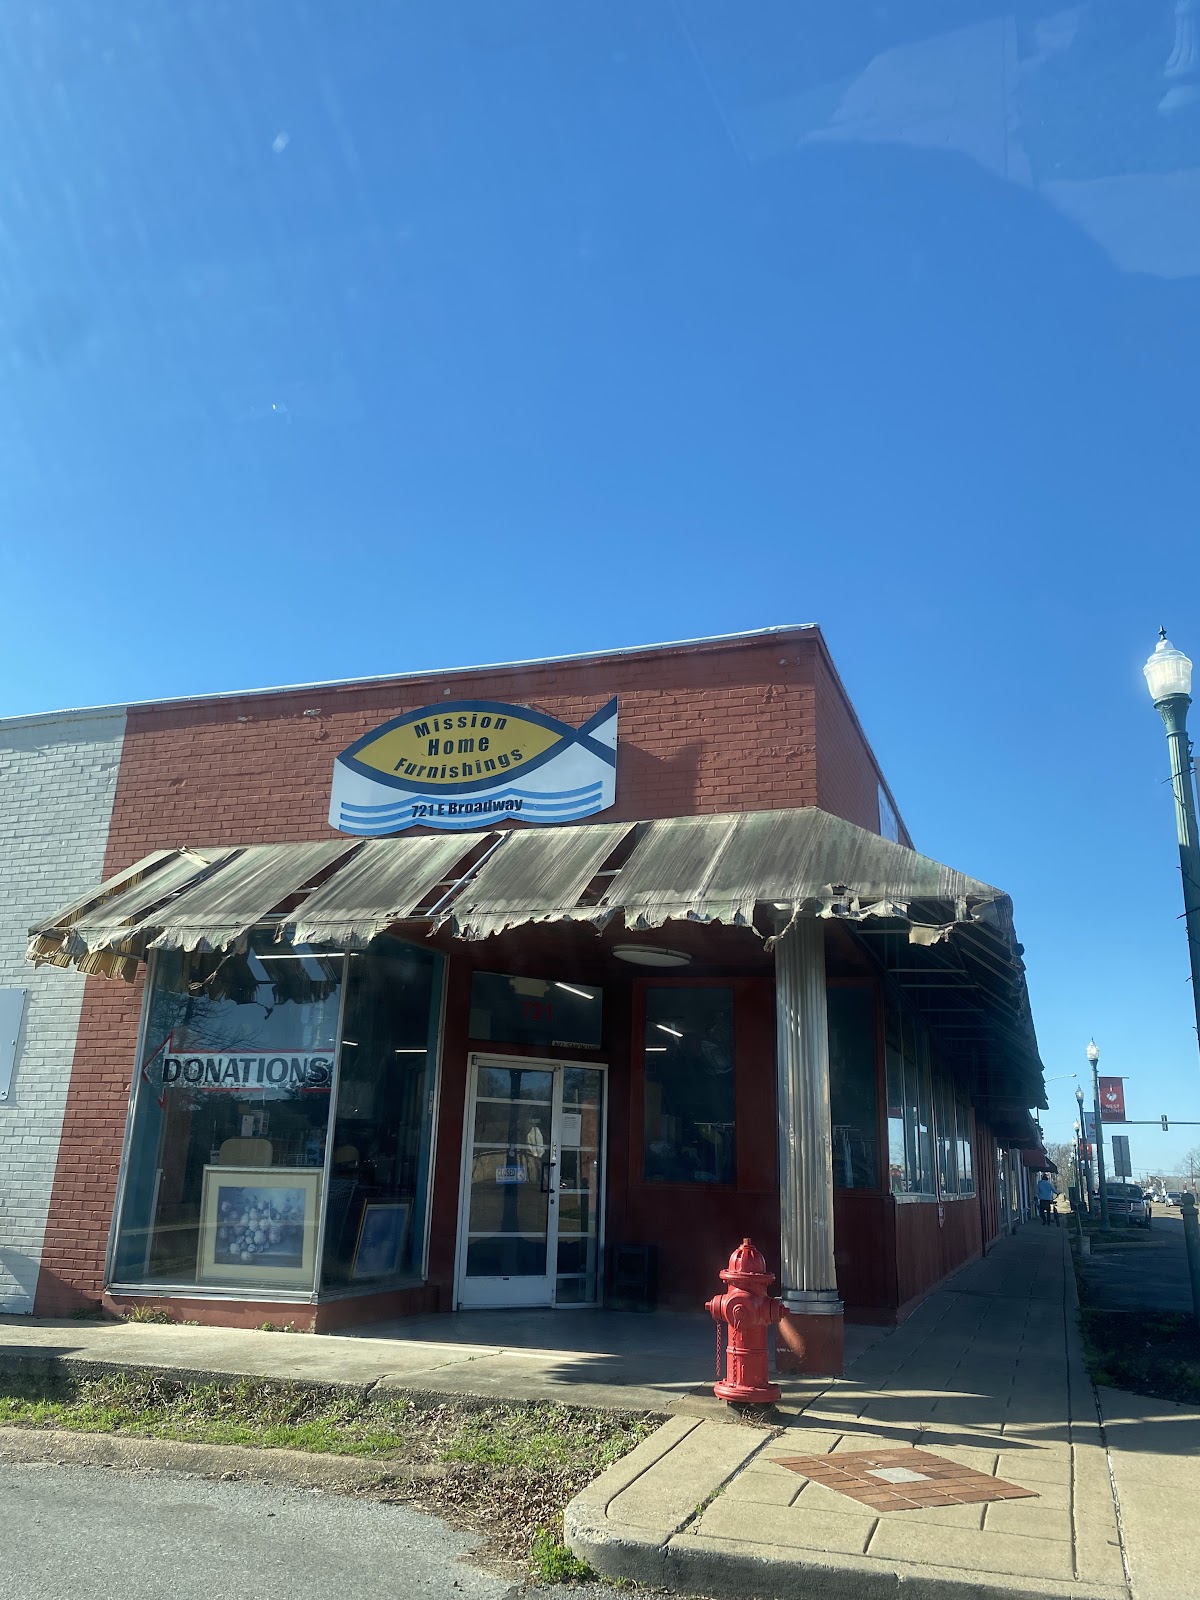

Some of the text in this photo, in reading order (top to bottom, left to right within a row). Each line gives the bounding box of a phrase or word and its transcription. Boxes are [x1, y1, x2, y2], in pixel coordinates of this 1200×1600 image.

[413, 713, 508, 738] Mission
[427, 736, 490, 756] Home
[393, 748, 523, 779] Furnishings
[412, 799, 523, 817] 721 E Broadway
[162, 1057, 329, 1083] DONATIONS
[497, 1168, 515, 1177] CLOSED
